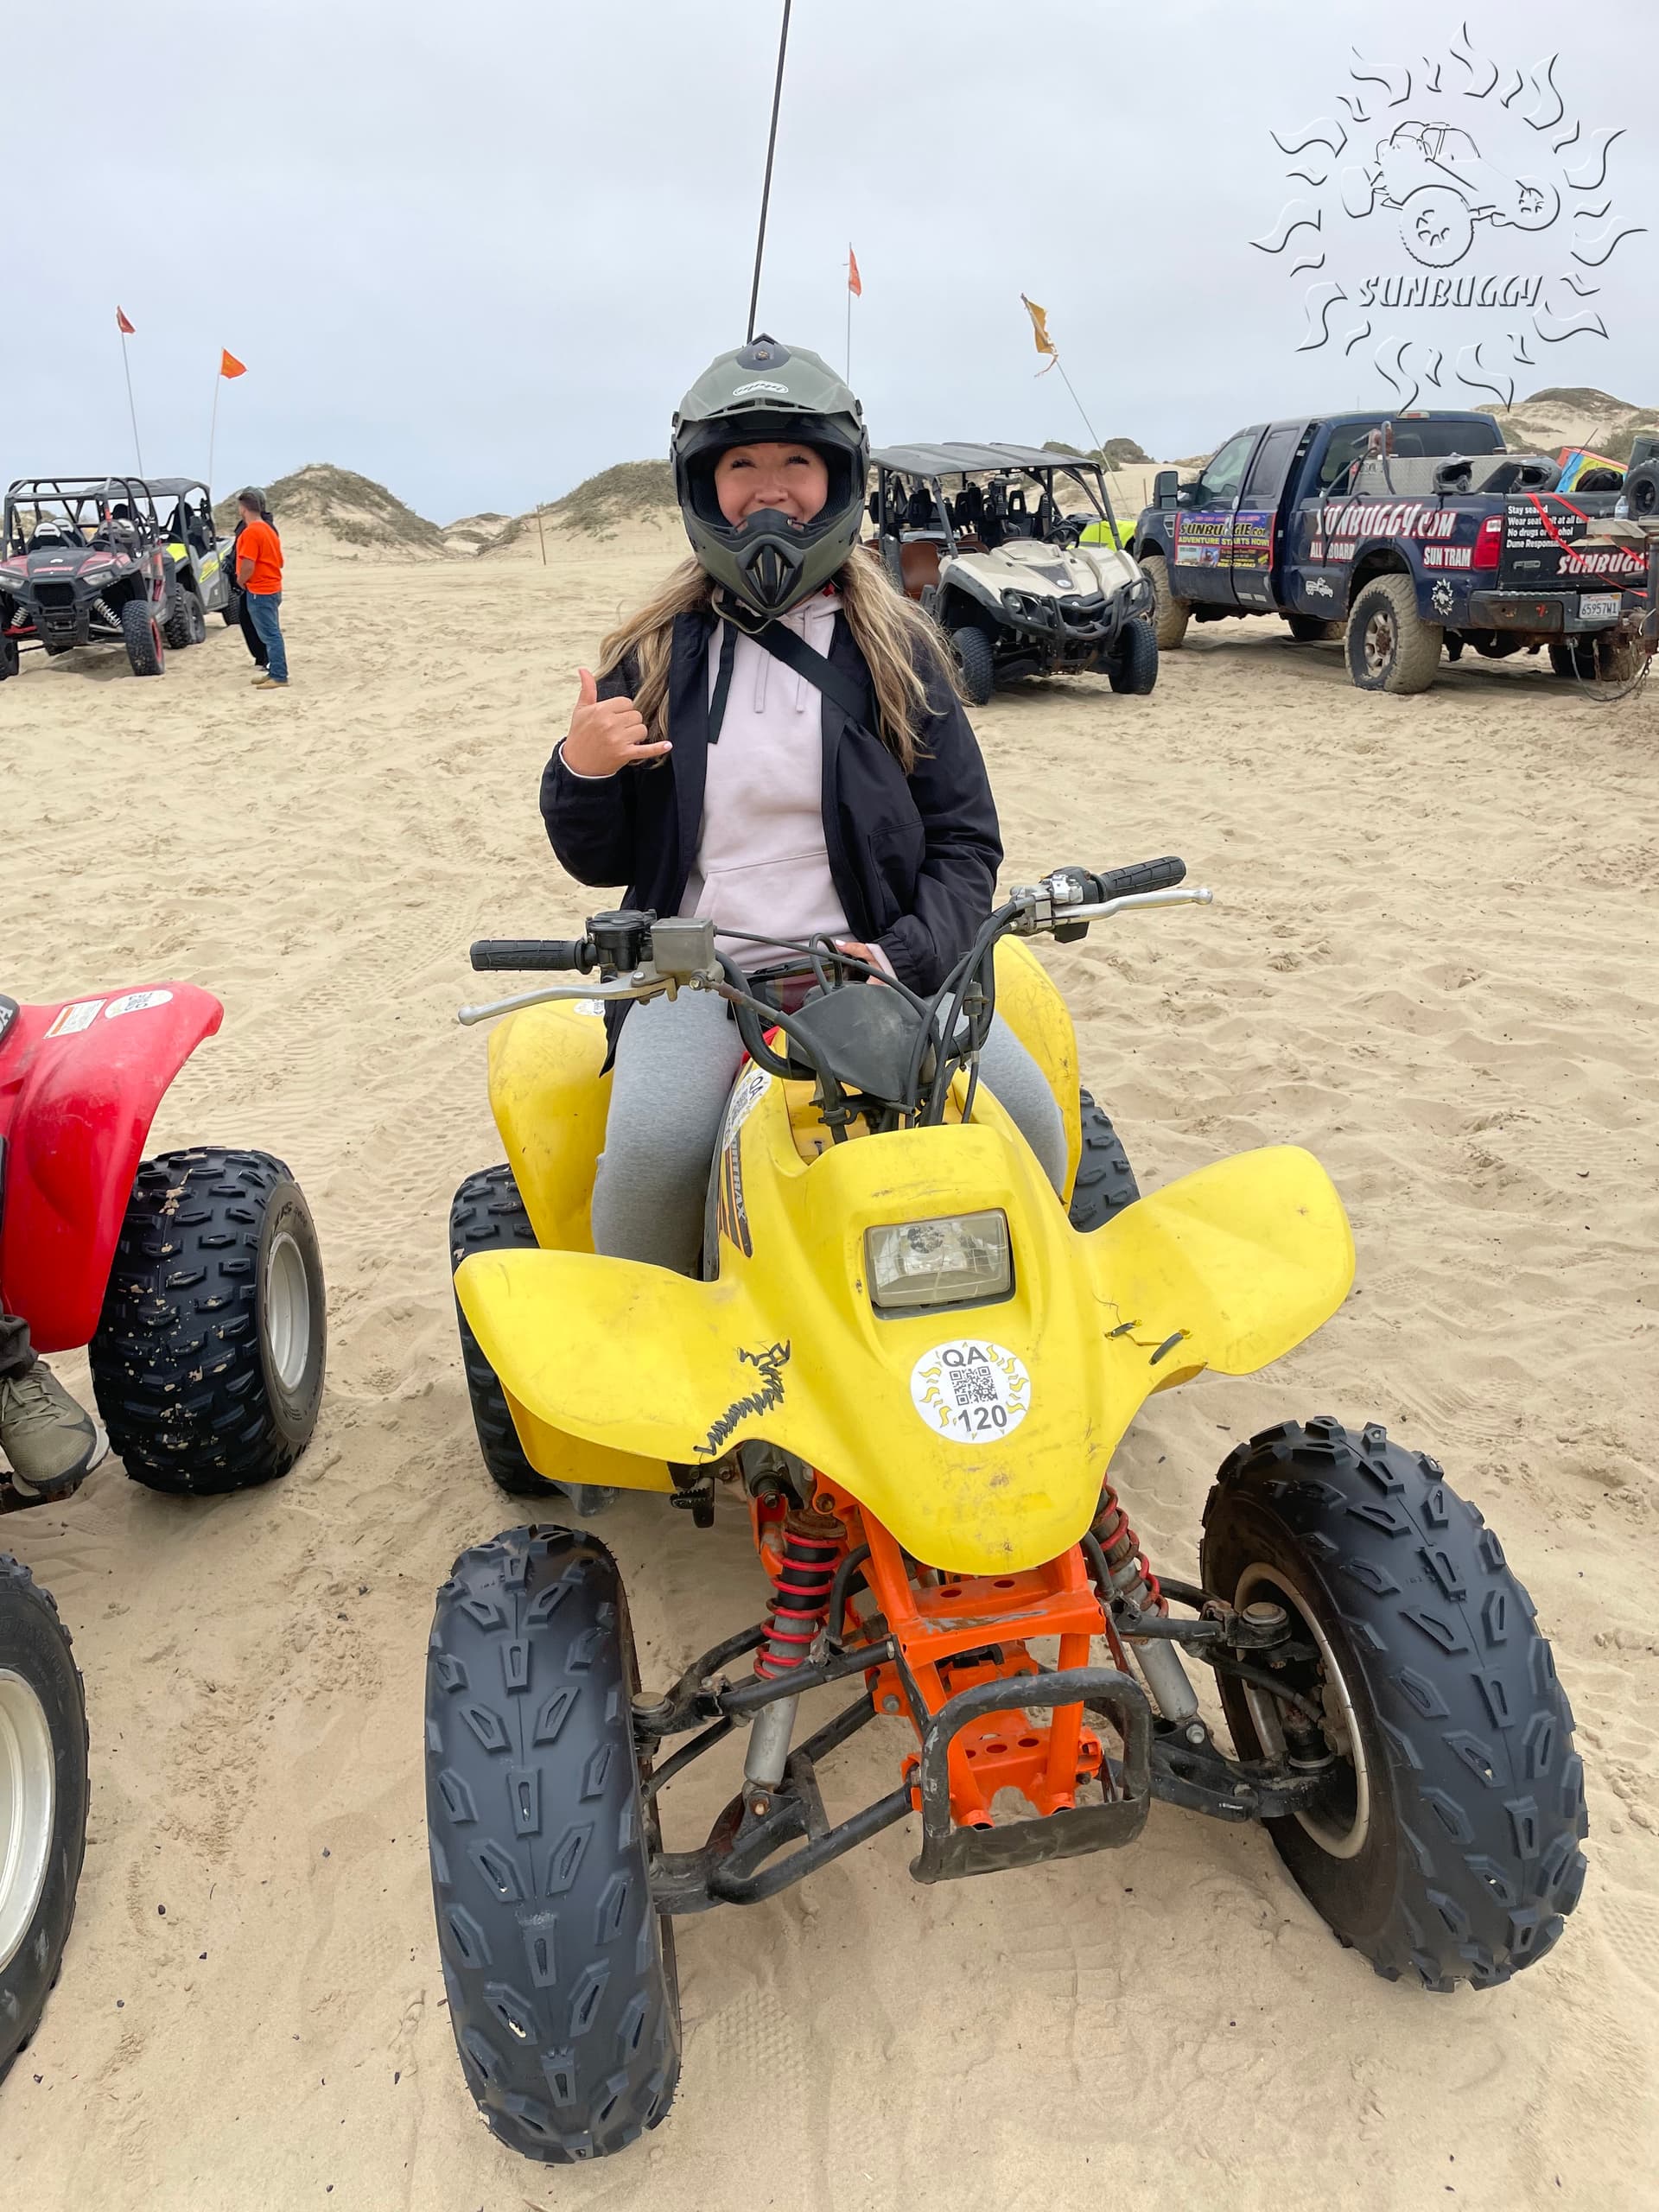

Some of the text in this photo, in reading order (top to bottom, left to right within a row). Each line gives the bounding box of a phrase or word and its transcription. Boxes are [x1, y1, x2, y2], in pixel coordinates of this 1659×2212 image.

[1508, 504, 1548, 516] Stay sead
[1508, 518, 1526, 526] Wear
[1528, 517, 1541, 525] seat
[1558, 515, 1565, 524] at
[1566, 514, 1575, 524] all
[1180, 523, 1265, 537] SUNBUGIE.co
[1508, 528, 1518, 537] No
[1519, 527, 1539, 537] drugs
[1179, 537, 1219, 545] ADVENTURE
[1506, 539, 1524, 548] Dune
[1310, 541, 1355, 560] ALL BOARD
[1424, 547, 1471, 567] SUN TRAM
[1556, 552, 1649, 575] SUNBUGG
[942, 1346, 988, 1367] QA
[958, 1404, 1007, 1433] 120
